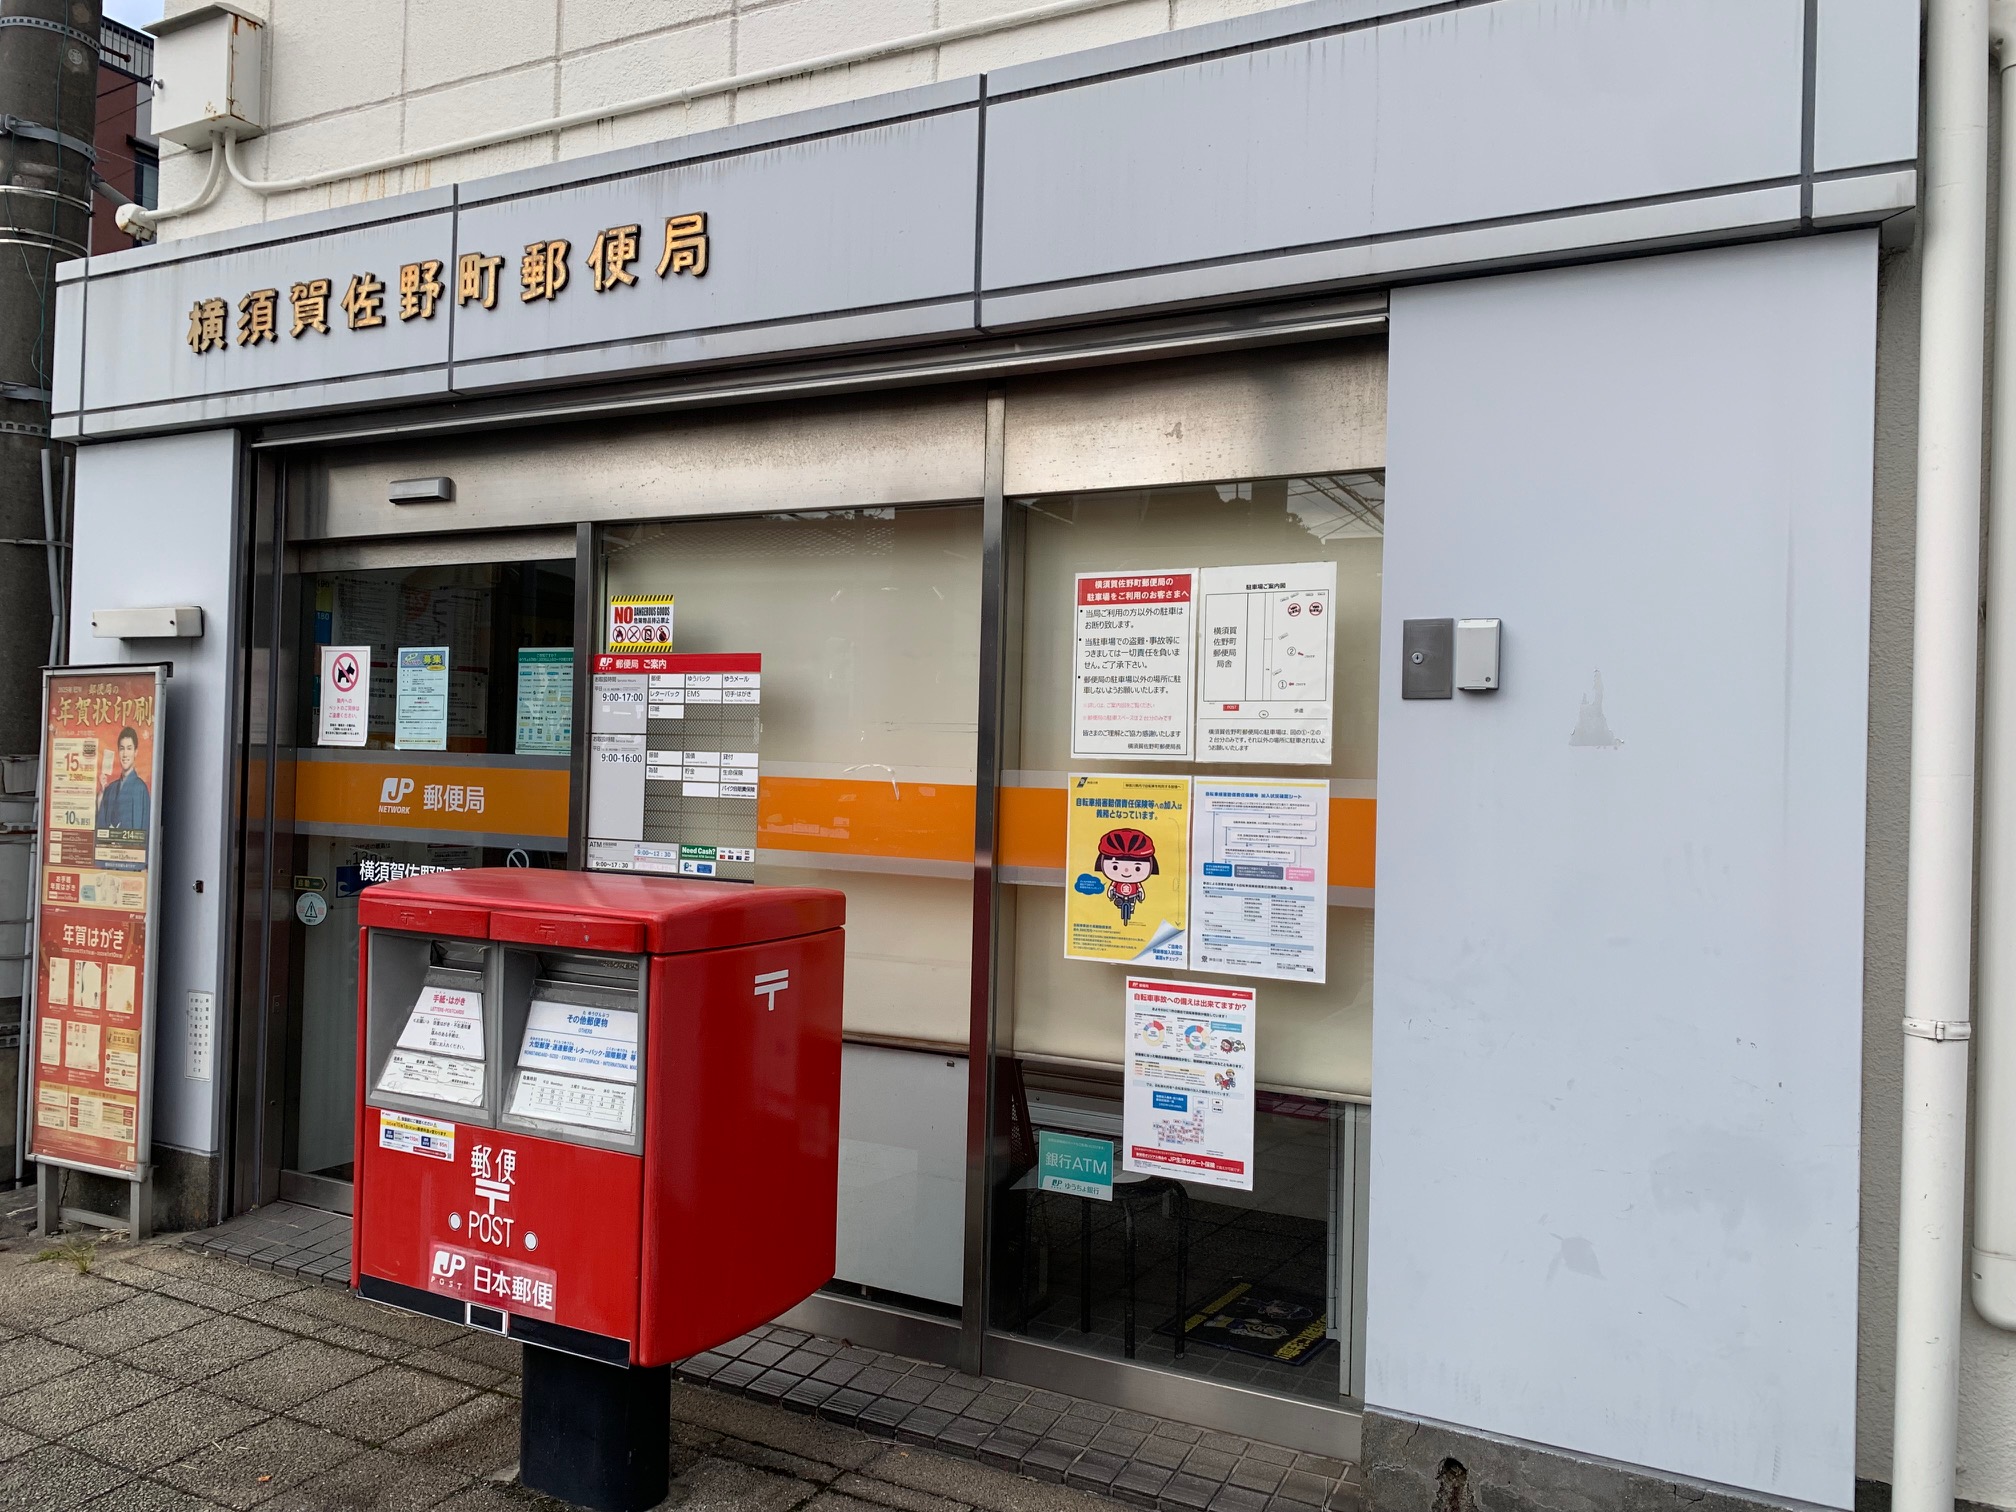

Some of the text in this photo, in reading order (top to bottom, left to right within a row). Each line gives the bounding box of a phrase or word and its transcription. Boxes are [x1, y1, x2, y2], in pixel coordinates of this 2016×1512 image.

[186, 210, 709, 355] 横須賀佐野町郵便局
[1094, 578, 1174, 590] 横須賀佐野町郵便局の
[1245, 582, 1287, 591] 駐車場ご案内図
[1086, 590, 1190, 602] 駐車場をご利用のお客さまへ
[613, 606, 634, 624] NO
[634, 606, 670, 616] DANGEROUS GOODS
[1085, 607, 1184, 618] 当局ご利用の方以外の駐車は
[1084, 620, 1135, 630] お断り致します。
[1213, 626, 1238, 636] 横須賀
[1084, 636, 1180, 647] 当駐車場での盗難・事故等に
[1213, 637, 1237, 646] 佐野町
[1084, 648, 1180, 658] つきましては一切責任を負いま
[1212, 648, 1237, 658] 郵便局
[422, 653, 443, 666] 募集
[615, 659, 639, 669] 郵便局
[643, 659, 667, 670] ご案内
[1084, 661, 1148, 670] せん。ご了承下さい。
[724, 675, 750, 683] ゆうメール
[1083, 675, 1181, 684] 郵便局の駐車場以外の場所に駐
[1083, 686, 1169, 694] 車しないようお願いいたします。
[602, 692, 644, 702] 9:00-17:00
[55, 695, 154, 727] 年賀状印刷
[601, 753, 643, 763] 9:00-16:00
[722, 769, 744, 777] 生命保険
[380, 777, 486, 814] JP 郵便局
[378, 805, 411, 815] NETWORK
[1075, 798, 1183, 810] 自転車損害賠償責任保険等への加入は
[1096, 809, 1158, 821] 義務となっています。
[681, 846, 716, 856] Need Cash?
[359, 859, 468, 883] 横須賀佐野
[62, 923, 124, 951] 年賀はがき
[432, 994, 466, 1007] 手紙・はがき
[1133, 992, 1247, 1011] 自転車事故への備えは出来てますか?
[566, 1014, 609, 1028] その他郵便物
[577, 1027, 593, 1035] OTHERS
[470, 1144, 517, 1185] 郵便
[1045, 1151, 1107, 1176] 銀行ATM
[1167, 1156, 1216, 1169] JP生活サポート保険
[1064, 1182, 1100, 1196] ゆうちょ銀行
[468, 1210, 515, 1248] POST
[430, 1275, 463, 1290] POST
[432, 1250, 554, 1310] JP 日本郵便
